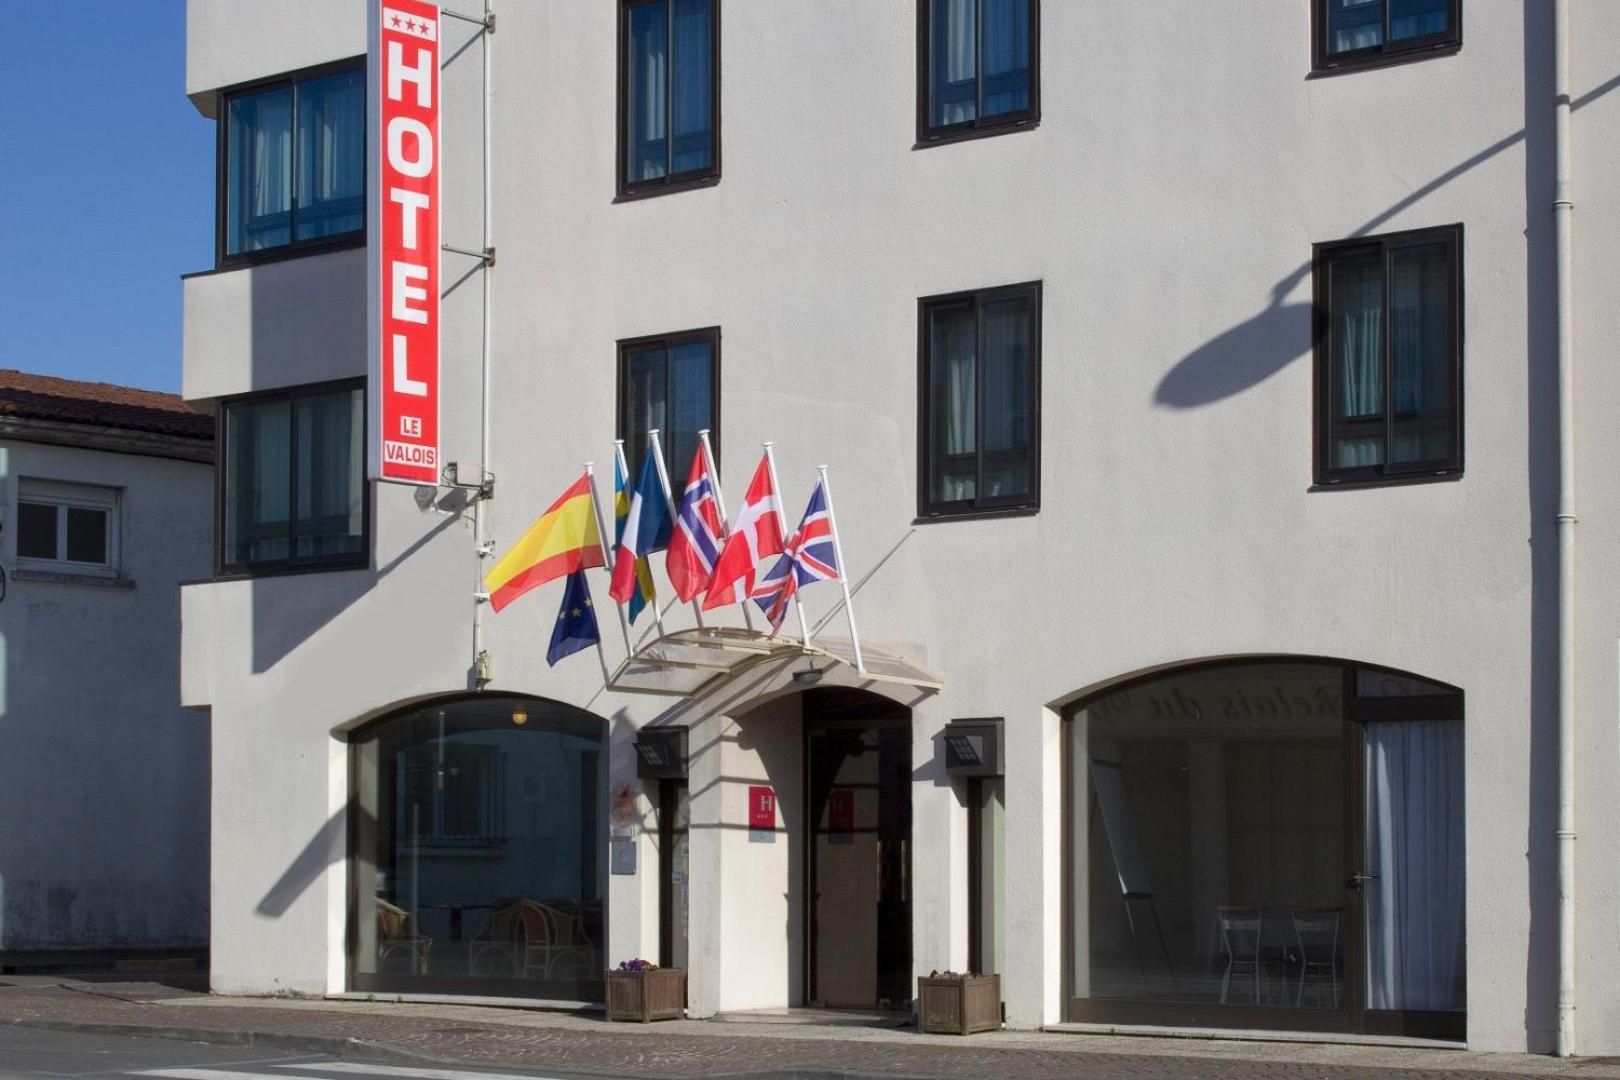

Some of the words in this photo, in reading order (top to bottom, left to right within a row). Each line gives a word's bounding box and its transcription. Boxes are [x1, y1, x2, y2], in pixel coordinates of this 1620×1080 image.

[387, 40, 434, 397] HOTEL
[403, 418, 419, 435] LE
[386, 444, 434, 465] VALOIS
[760, 795, 774, 812] H
